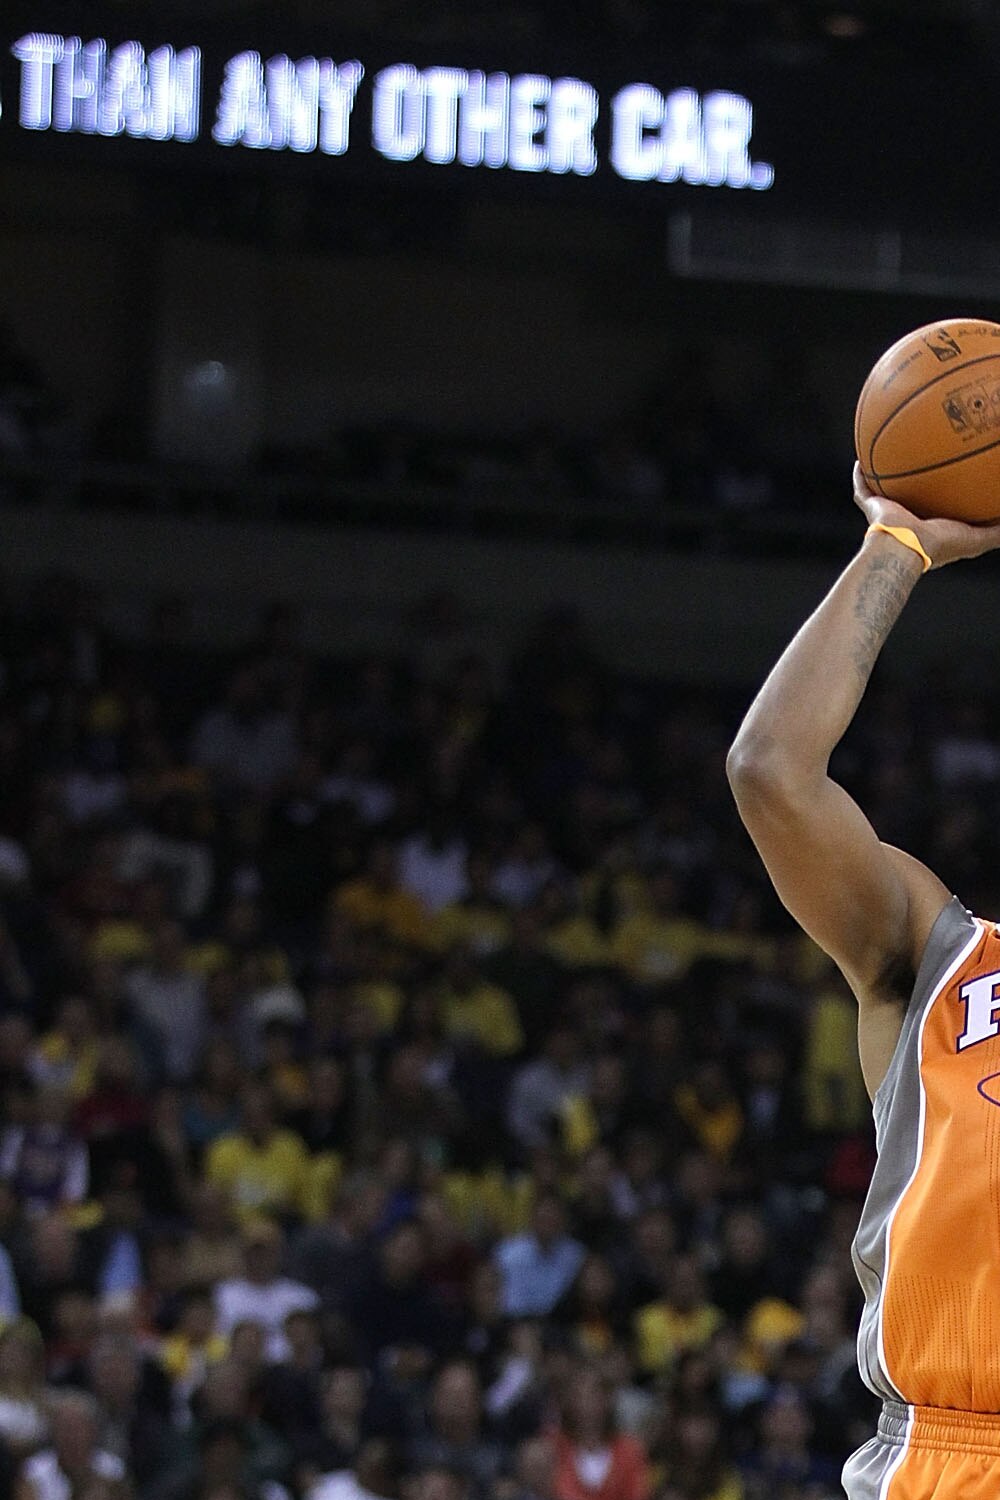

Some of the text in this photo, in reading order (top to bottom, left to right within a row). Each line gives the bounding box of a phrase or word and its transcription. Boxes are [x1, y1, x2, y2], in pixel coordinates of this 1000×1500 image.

[12, 33, 774, 190] THAN ANY OTHER CAR.
